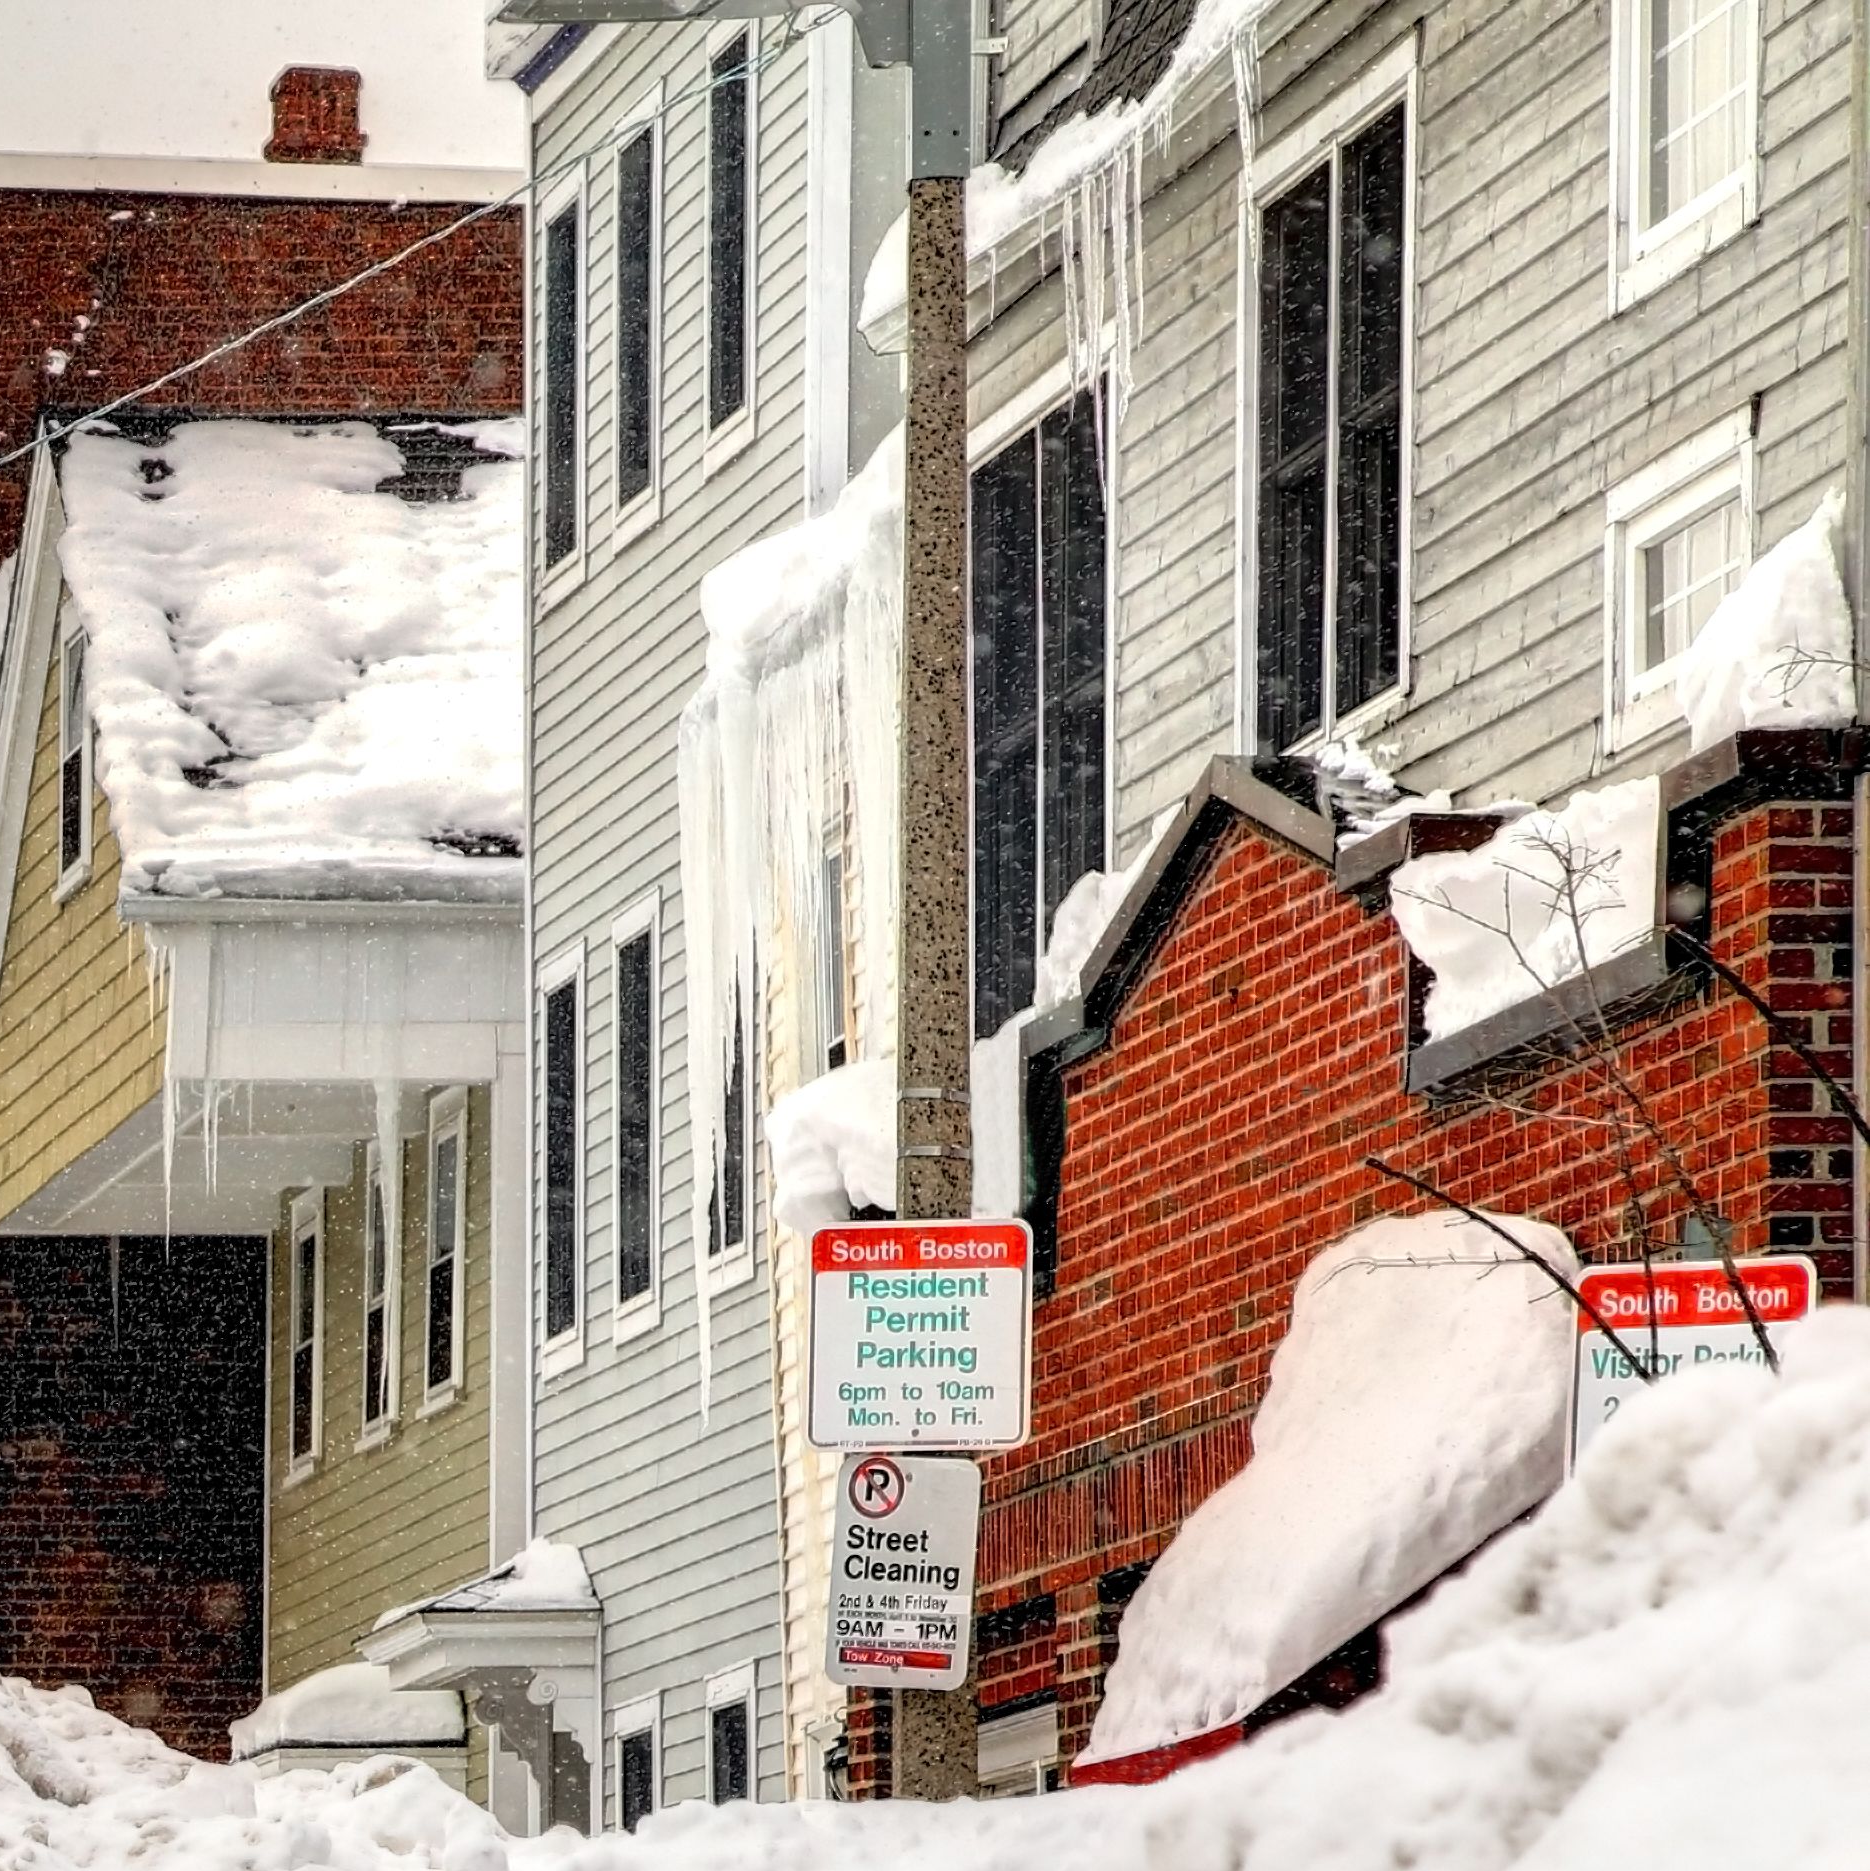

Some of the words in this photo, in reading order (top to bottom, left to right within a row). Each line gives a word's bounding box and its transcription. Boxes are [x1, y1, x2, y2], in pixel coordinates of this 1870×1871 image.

[831, 1239, 904, 1262] South
[919, 1238, 1008, 1260] Boston
[848, 1271, 989, 1299] Resident
[1598, 1285, 1679, 1318] South
[1697, 1283, 1789, 1313] Boston
[865, 1305, 970, 1333] Permit
[856, 1341, 978, 1373] Parking
[838, 1382, 886, 1405] 6pm
[901, 1383, 923, 1400] to
[936, 1381, 994, 1400] 10am
[847, 1407, 900, 1427] Mon.
[915, 1408, 936, 1426] to
[951, 1406, 983, 1426] Fri.
[846, 1524, 929, 1552] Street
[844, 1554, 960, 1591] Cleaning
[839, 1593, 860, 1609] 2nd
[866, 1594, 874, 1609] &
[880, 1595, 900, 1610] 4th
[905, 1595, 948, 1612] Friday
[836, 1619, 884, 1637] 9AM
[915, 1623, 957, 1640] 1PM
[844, 1650, 868, 1662] Tow
[874, 1652, 904, 1665] Zone
